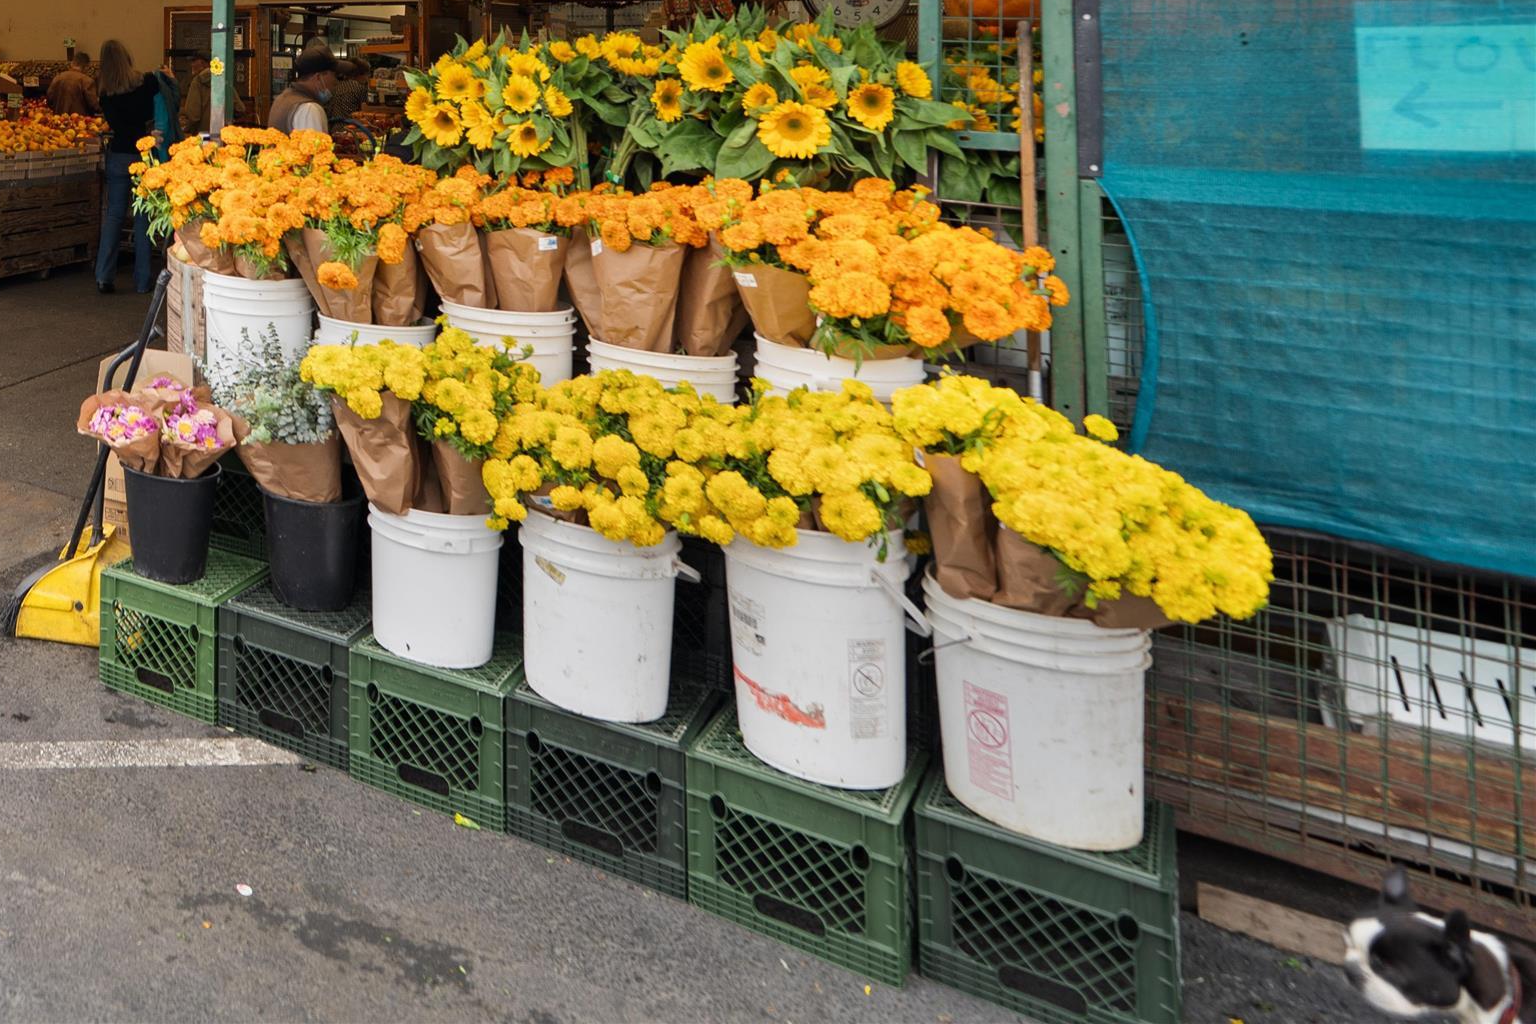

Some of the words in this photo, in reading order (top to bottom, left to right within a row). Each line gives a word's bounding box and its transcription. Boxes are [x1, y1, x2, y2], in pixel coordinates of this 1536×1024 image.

[834, 6, 841, 16] 6
[873, 6, 880, 15] 4
[854, 11, 861, 21] 5
